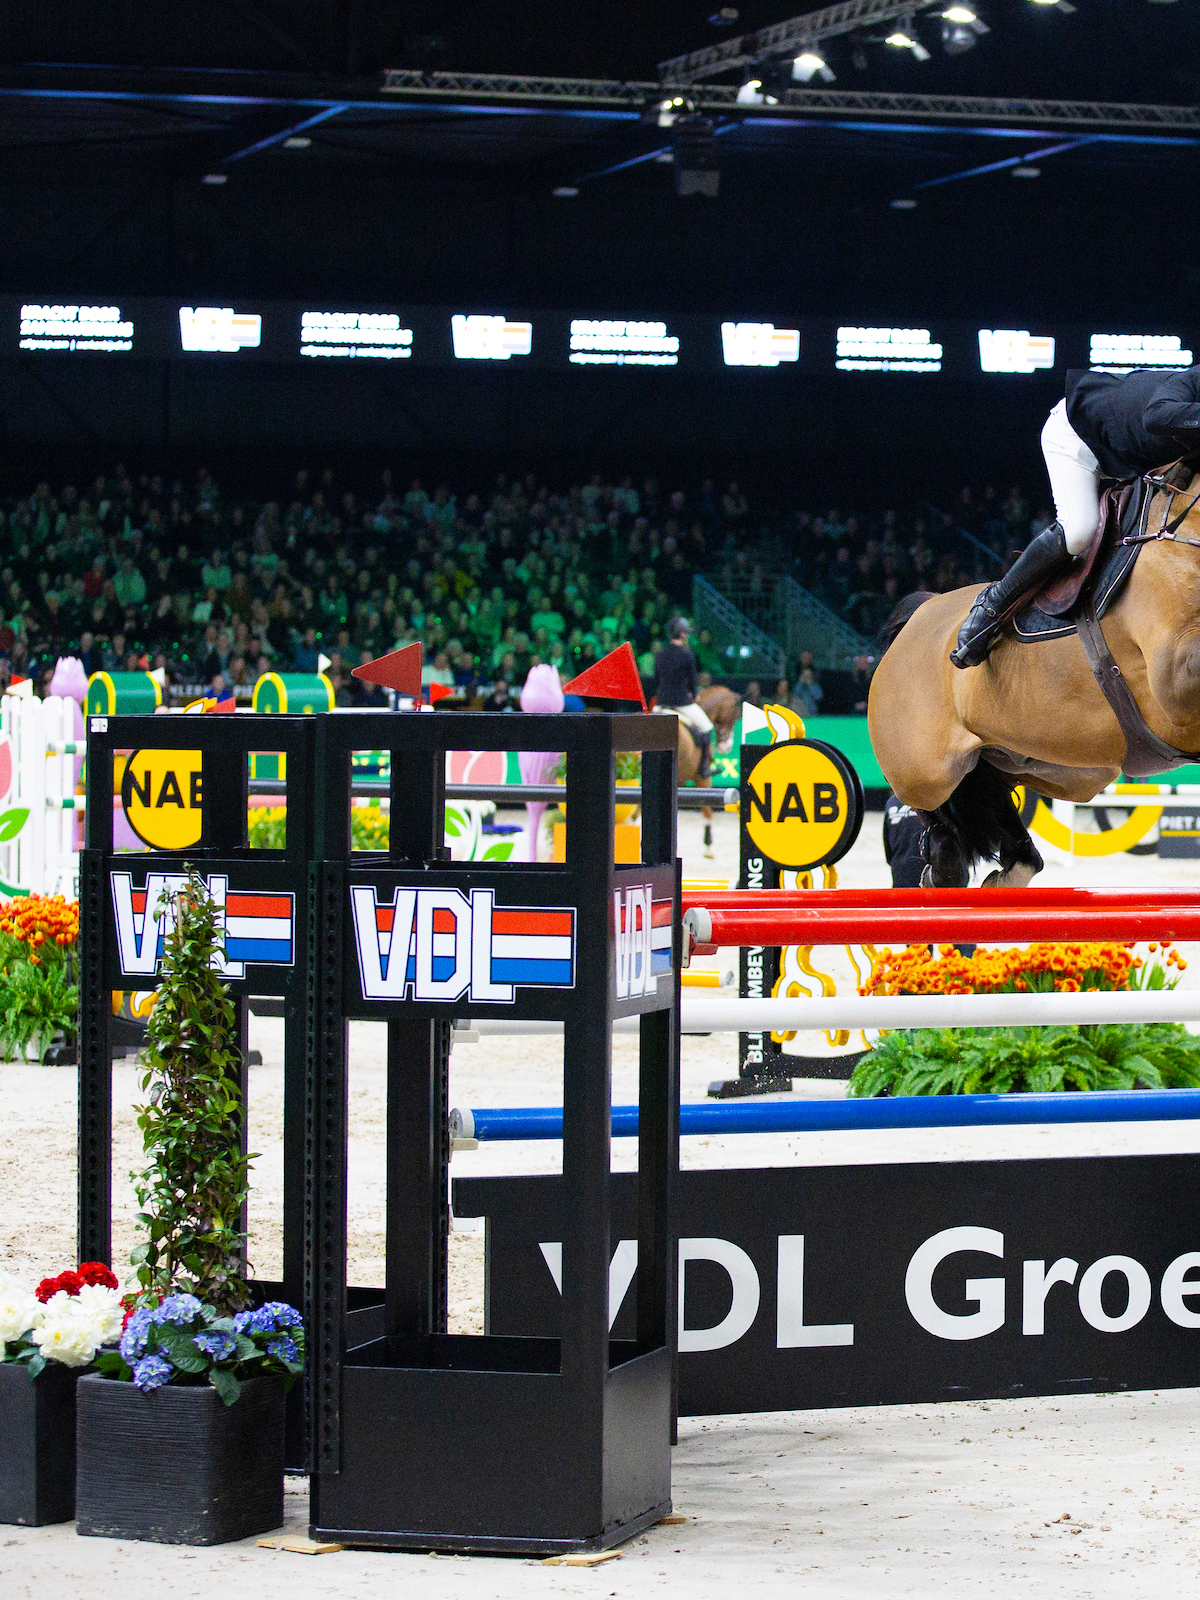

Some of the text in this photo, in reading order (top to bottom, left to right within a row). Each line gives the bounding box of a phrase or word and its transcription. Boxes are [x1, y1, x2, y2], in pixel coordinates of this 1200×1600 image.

[747, 782, 840, 823] NAB
[1160, 815, 1195, 830] PIET
[350, 885, 515, 1004] VDL
[614, 884, 657, 1002] VDL
